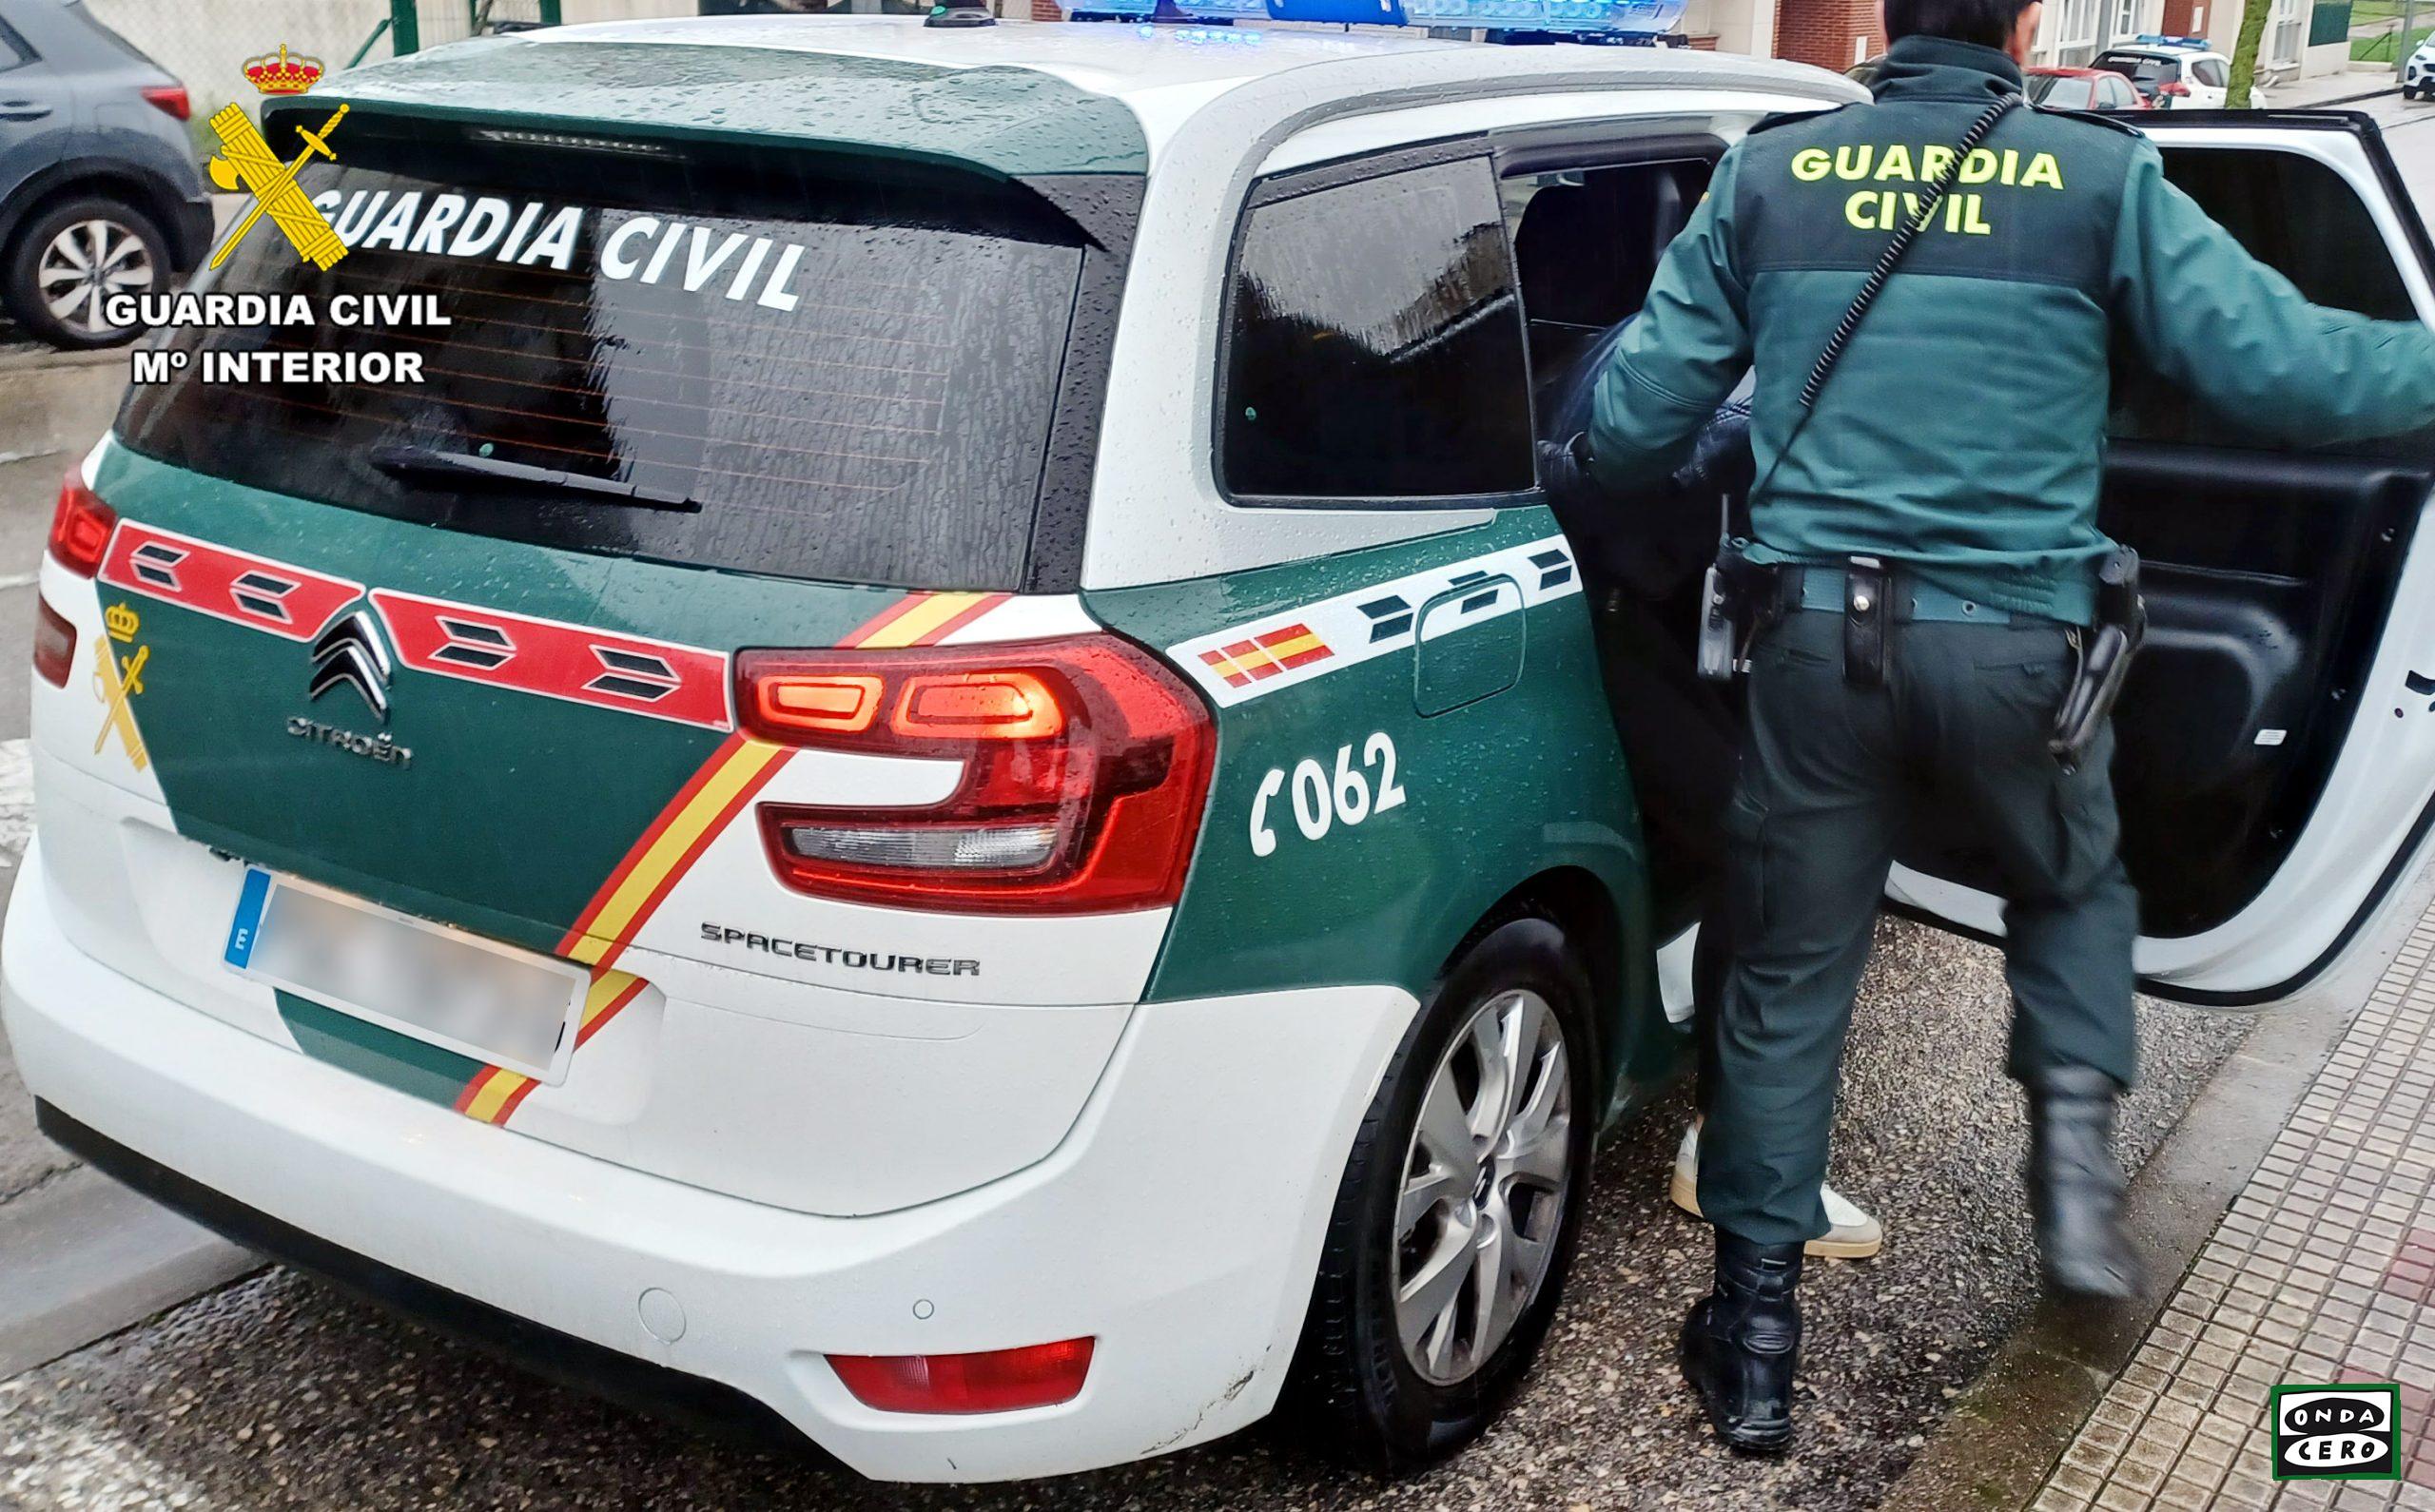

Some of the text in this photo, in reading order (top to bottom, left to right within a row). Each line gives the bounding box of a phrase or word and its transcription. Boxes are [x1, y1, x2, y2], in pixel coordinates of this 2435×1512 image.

[1791, 145, 2064, 235] GUARDIA CIVIL
[600, 216, 805, 312] CIVIL
[1291, 731, 1407, 841] 062
[235, 927, 248, 950] E
[701, 921, 981, 977] SPACETOURER
